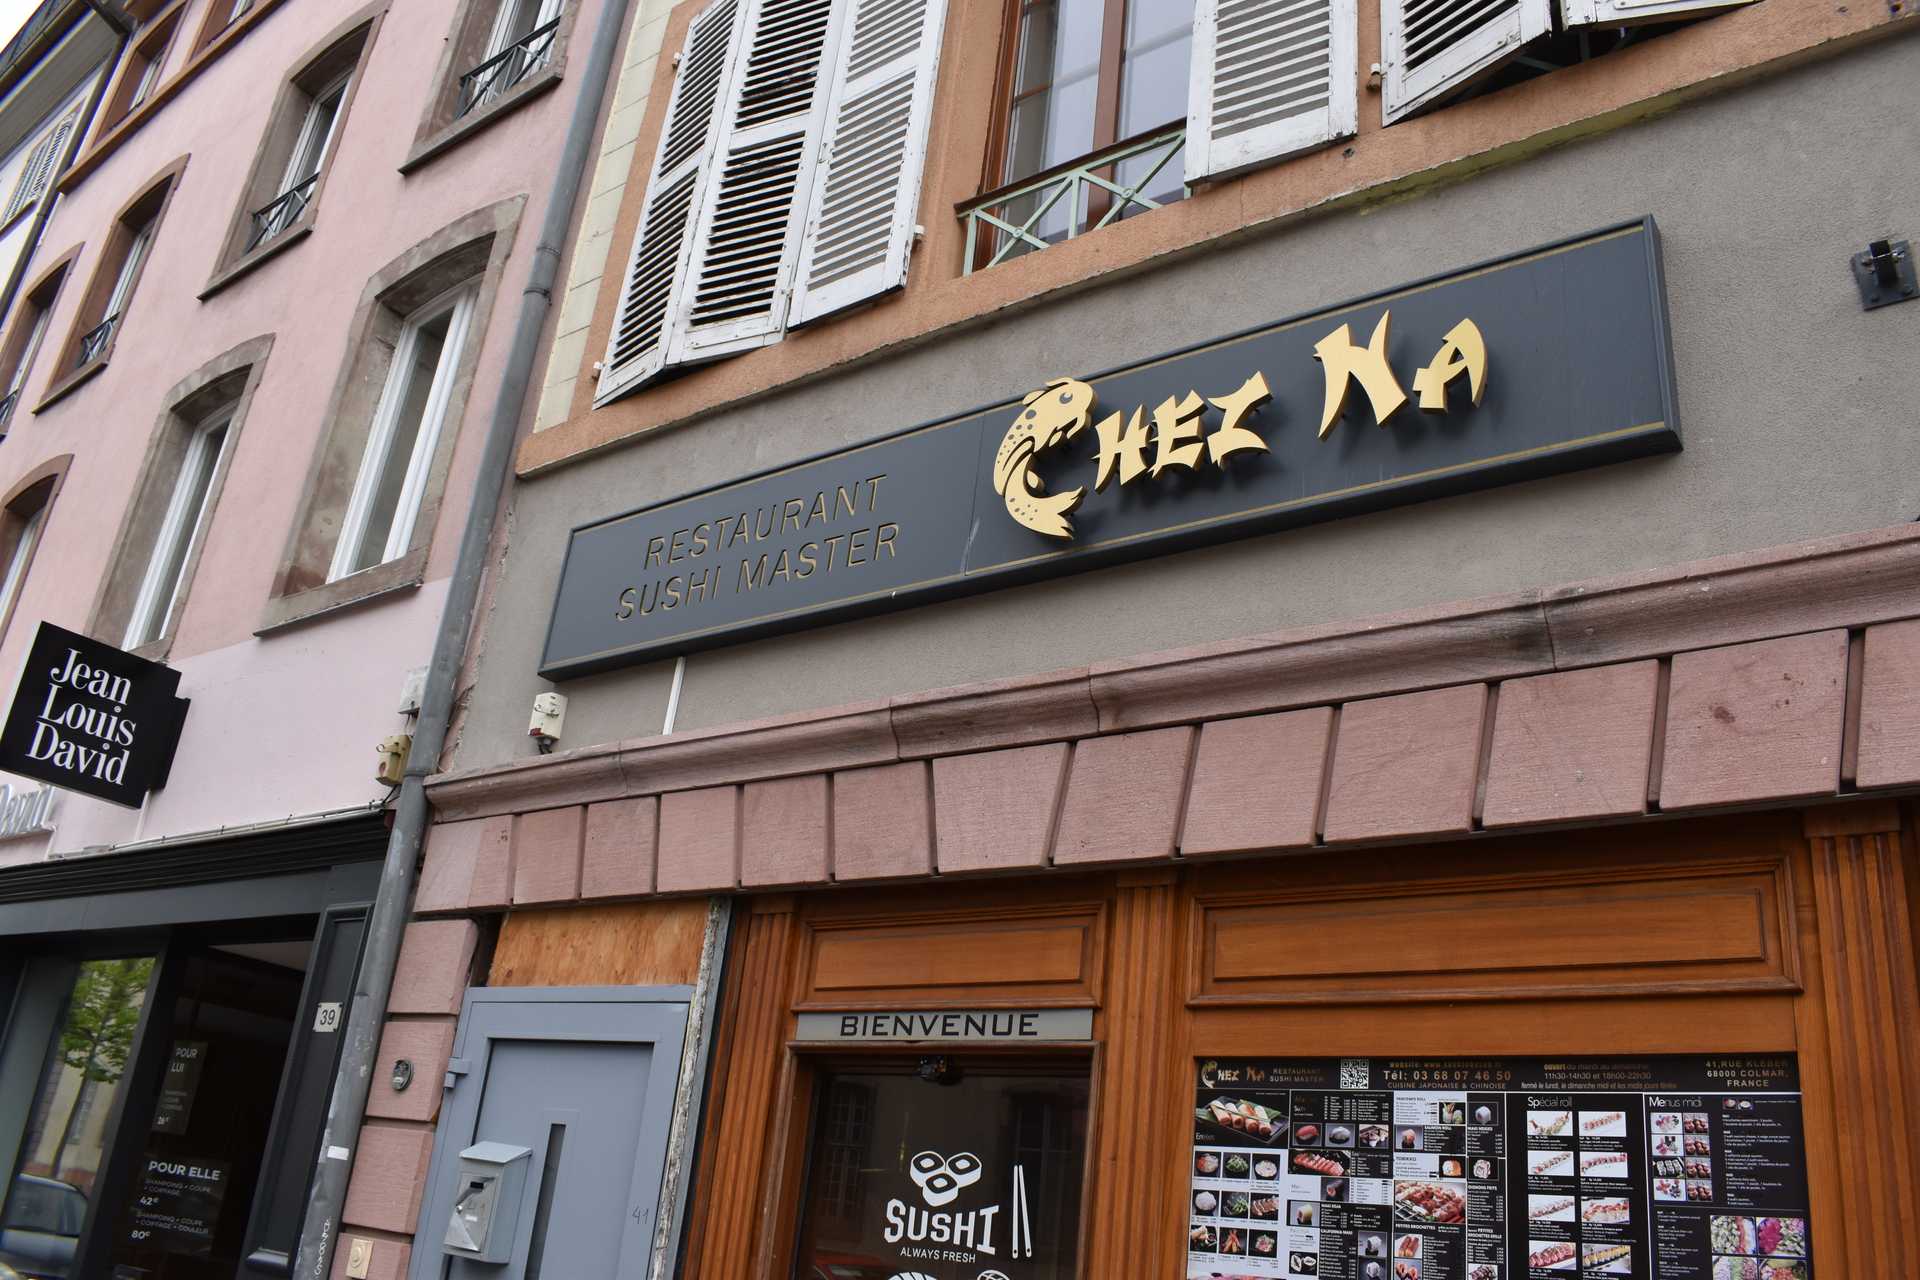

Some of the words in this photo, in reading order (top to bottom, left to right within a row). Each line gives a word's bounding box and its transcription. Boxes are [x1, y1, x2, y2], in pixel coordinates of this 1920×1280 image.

[1312, 309, 1488, 441] NA
[643, 473, 888, 570] RESTAURANT
[615, 565, 721, 622] SUSHI
[736, 522, 900, 594] MASTER
[50, 648, 132, 706] Jean
[38, 682, 137, 746] Louis
[25, 720, 131, 786] David
[320, 1008, 336, 1025] 39
[839, 1013, 1040, 1037] BIENVENUE
[175, 1047, 198, 1058] POUR
[170, 1063, 185, 1073] LUI
[1384, 1070, 1408, 1080] Tél:
[1413, 1070, 1428, 1081] 03
[1454, 1070, 1469, 1081] 07
[1727, 1079, 1769, 1087] FRANCE
[1527, 1096, 1559, 1109] Spécial
[1649, 1096, 1681, 1107] Menus
[148, 1161, 185, 1176] POUR
[188, 1166, 221, 1181] ELLE
[140, 1196, 159, 1206] 42€
[131, 1230, 151, 1240] 80€
[884, 1198, 1000, 1256] SUSHI
[900, 1247, 940, 1260] ALWAYS
[942, 1250, 976, 1263] FRESH
